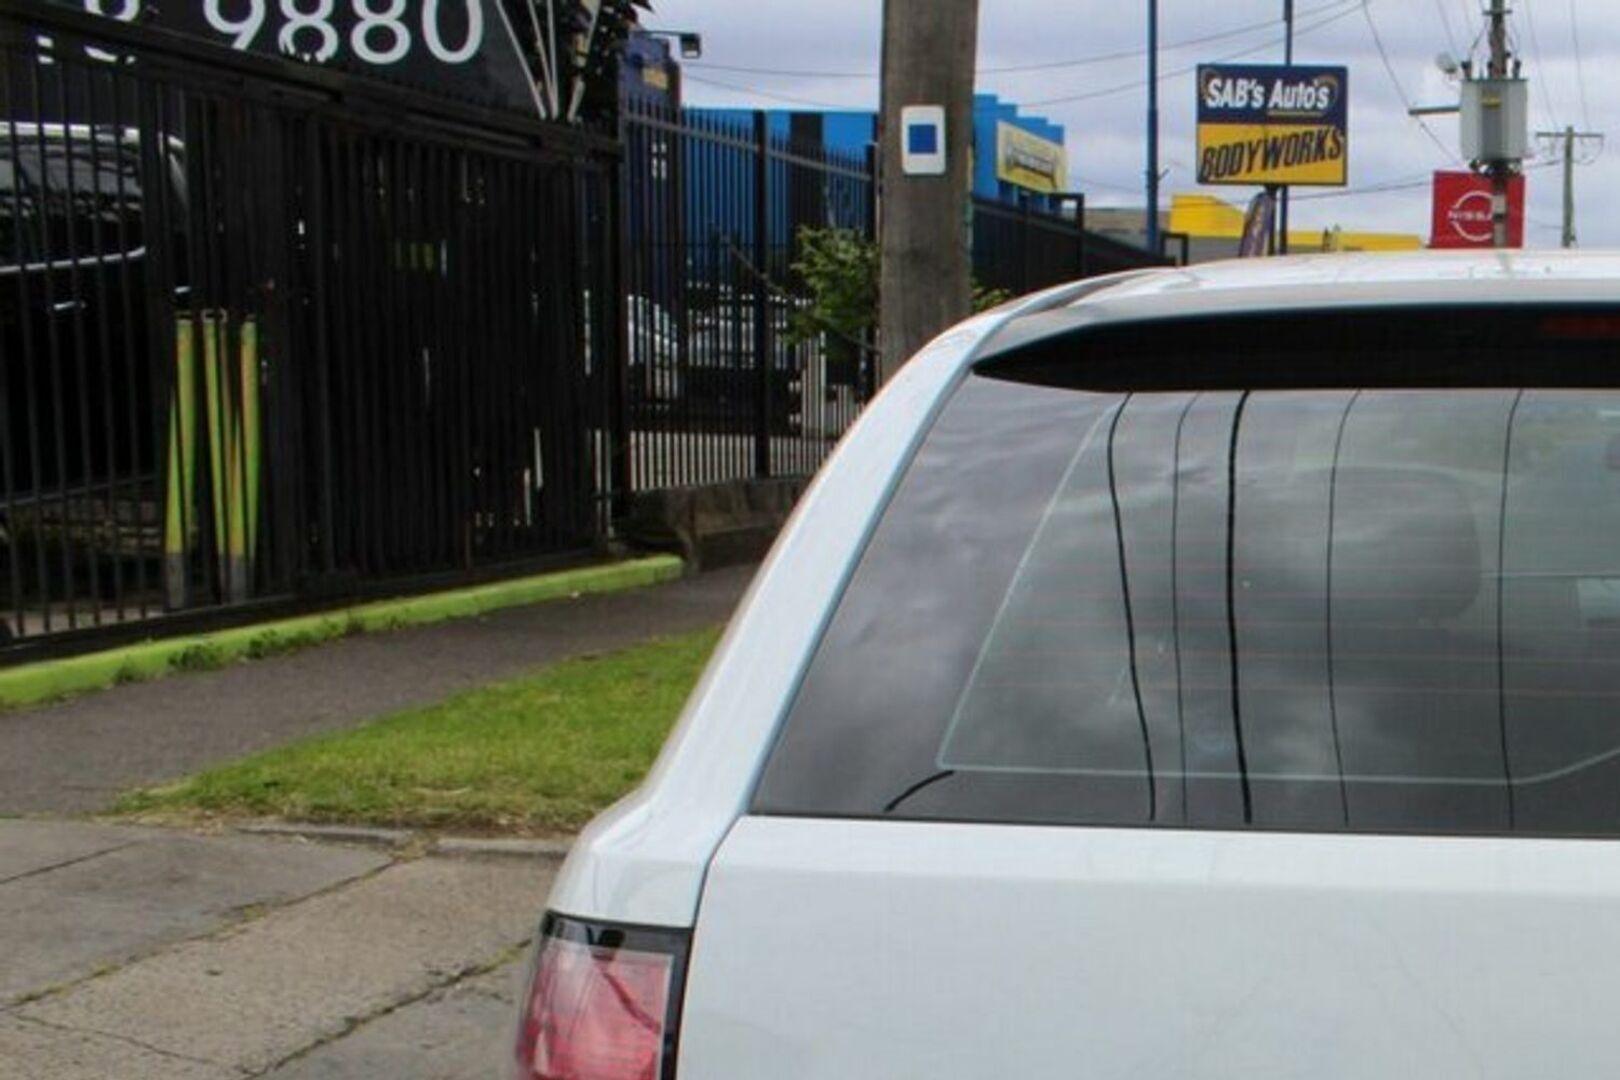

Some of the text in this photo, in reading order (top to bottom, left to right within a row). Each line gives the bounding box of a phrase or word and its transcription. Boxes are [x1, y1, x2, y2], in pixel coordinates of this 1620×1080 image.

[204, 0, 485, 65] 9880
[1206, 78, 1330, 109] SAB's Auto's
[1201, 127, 1344, 181] BODYWORKS
